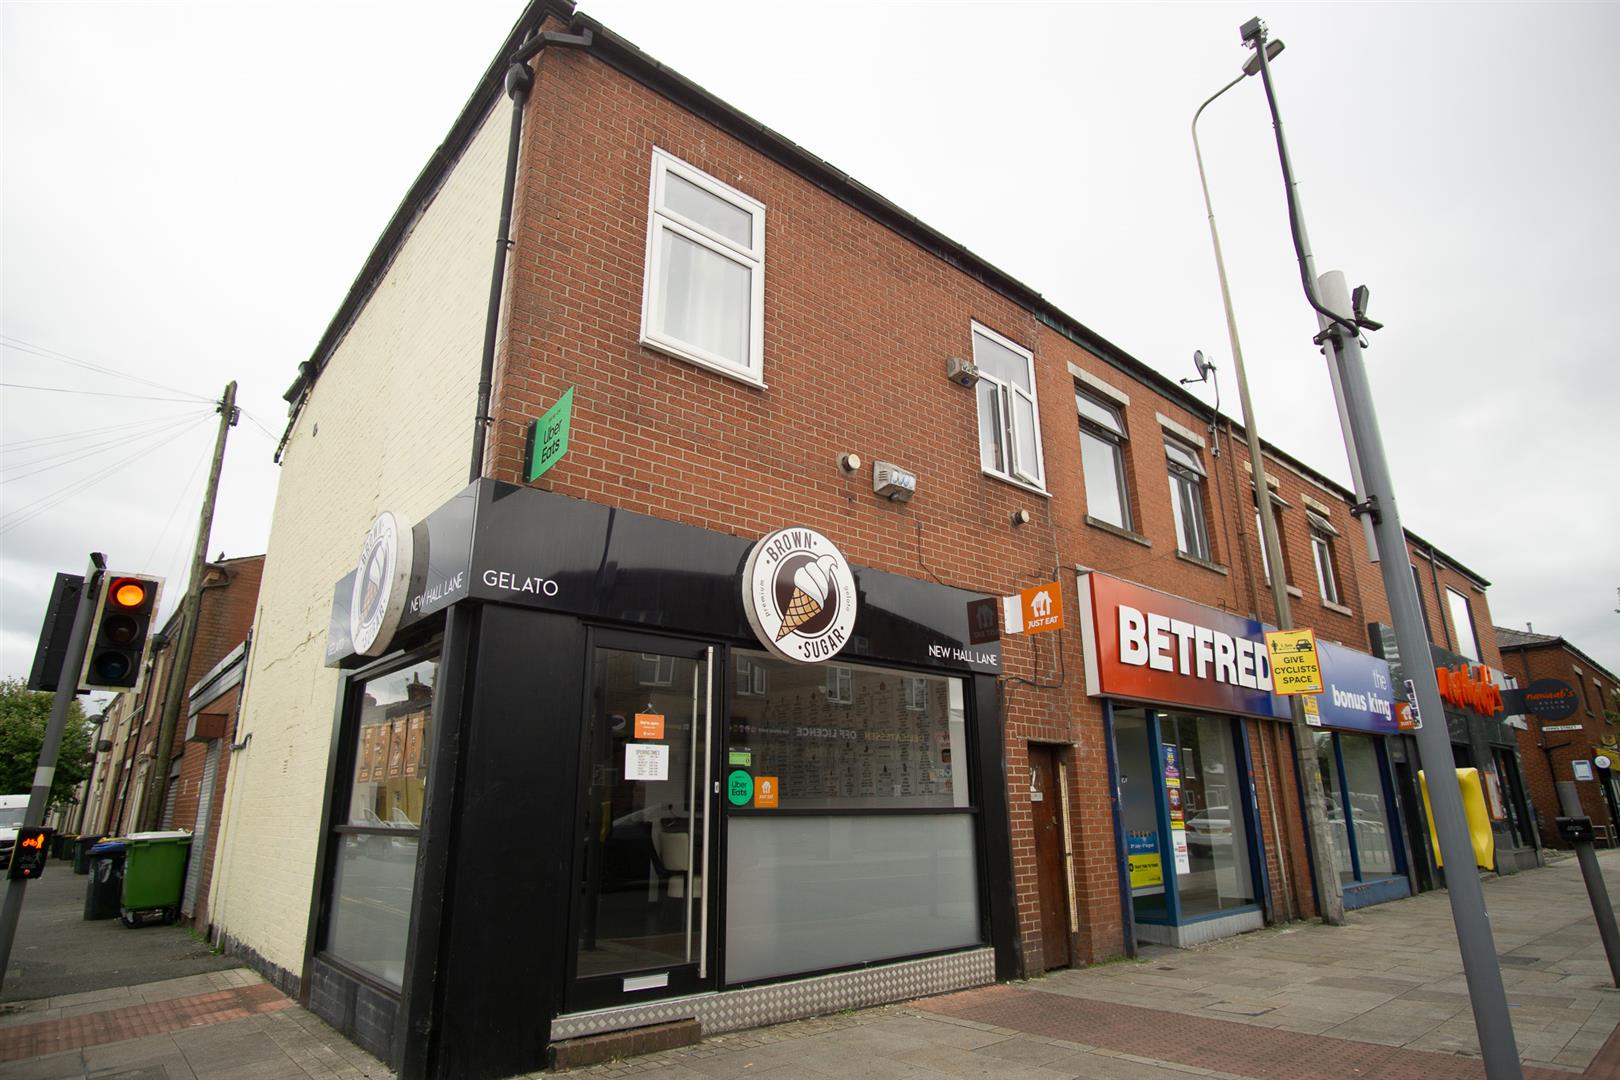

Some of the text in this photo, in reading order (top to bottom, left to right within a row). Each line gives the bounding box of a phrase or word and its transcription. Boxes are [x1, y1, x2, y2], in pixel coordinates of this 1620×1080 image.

[543, 419, 562, 445] Uber
[541, 439, 560, 464] Eats
[766, 531, 812, 562] BROWN
[409, 571, 464, 614] NEW HALL LANE
[483, 569, 559, 596] GELATO
[1028, 615, 1059, 629] JUST EAT
[803, 628, 845, 659] SUGAR
[928, 644, 998, 666] NEW HALL LANE
[1119, 604, 1274, 692] BETFRED
[1274, 665, 1317, 675] CYCLISTS
[1283, 656, 1304, 664] GIVE
[1282, 676, 1313, 685] SPACE
[1373, 669, 1387, 690] the
[1331, 684, 1368, 711] bonus
[1367, 692, 1392, 721] king
[731, 780, 748, 788] Uber
[731, 789, 748, 797] Eats
